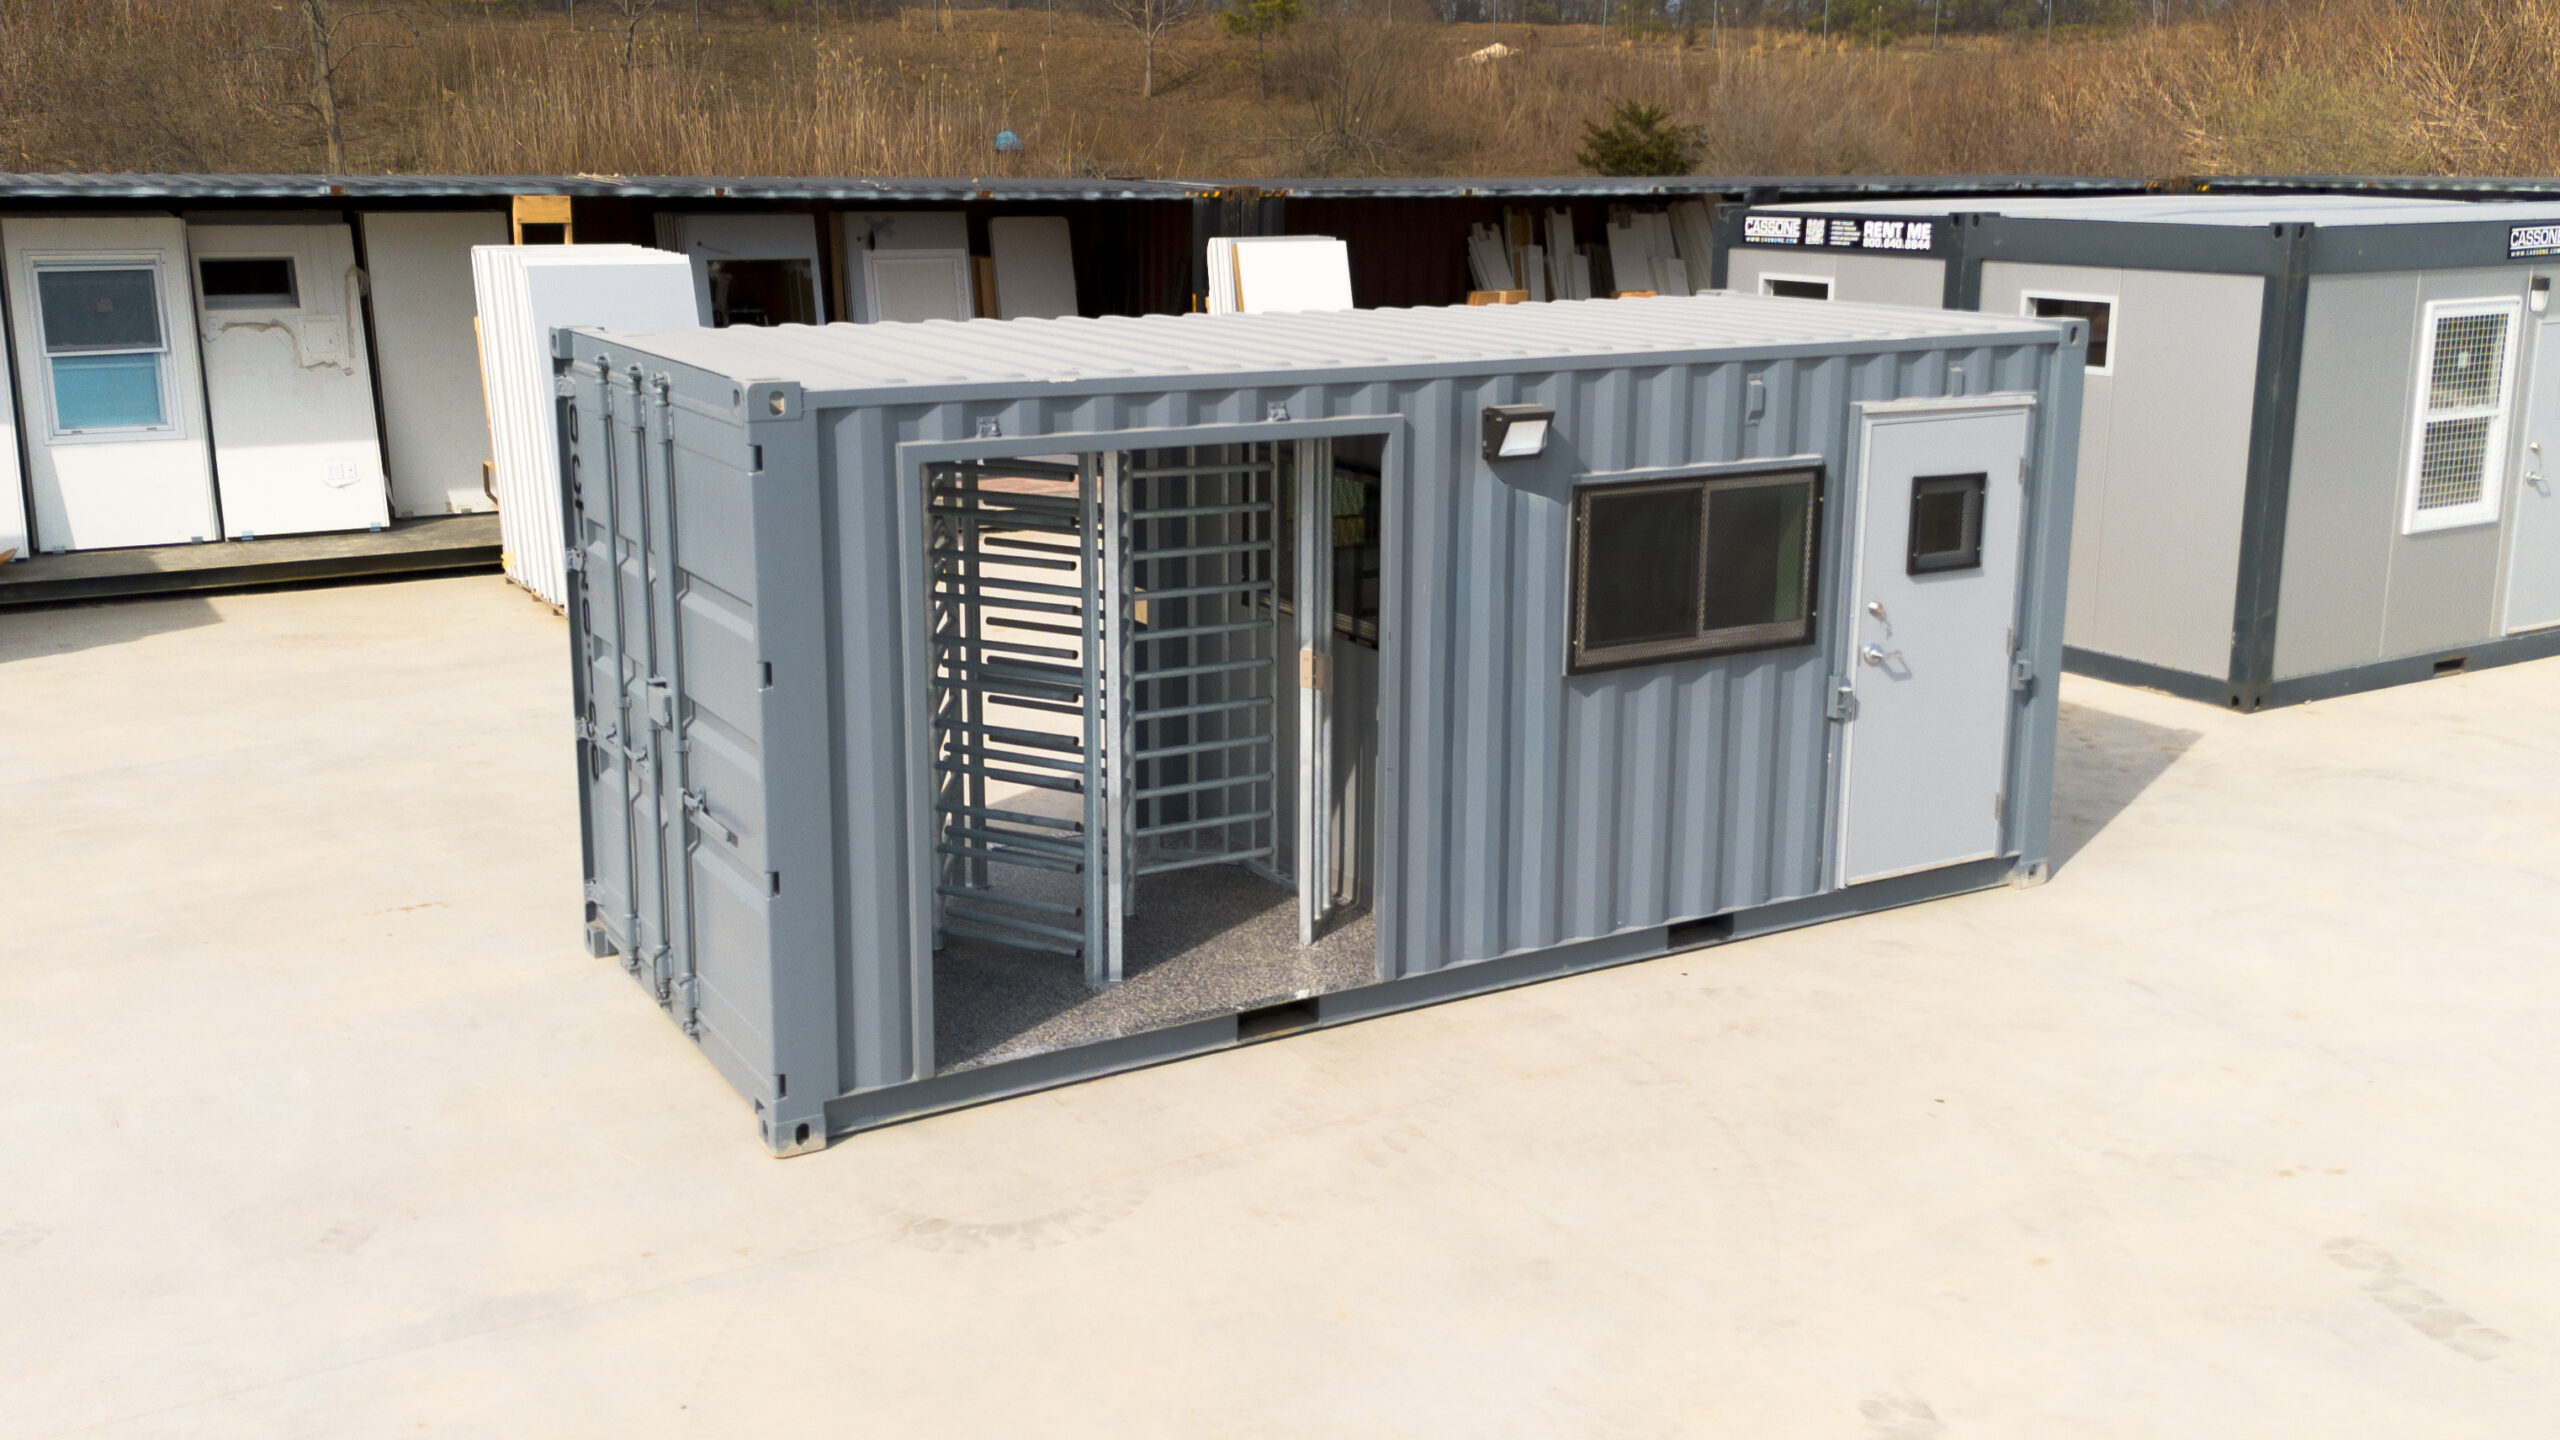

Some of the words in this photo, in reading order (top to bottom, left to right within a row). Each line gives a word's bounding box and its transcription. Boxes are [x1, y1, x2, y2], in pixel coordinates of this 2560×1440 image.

[1745, 219, 1800, 235] CASSONE
[1863, 221, 1904, 238] RENT
[1907, 222, 1931, 239] ME
[2510, 229, 2560, 247] CASSON
